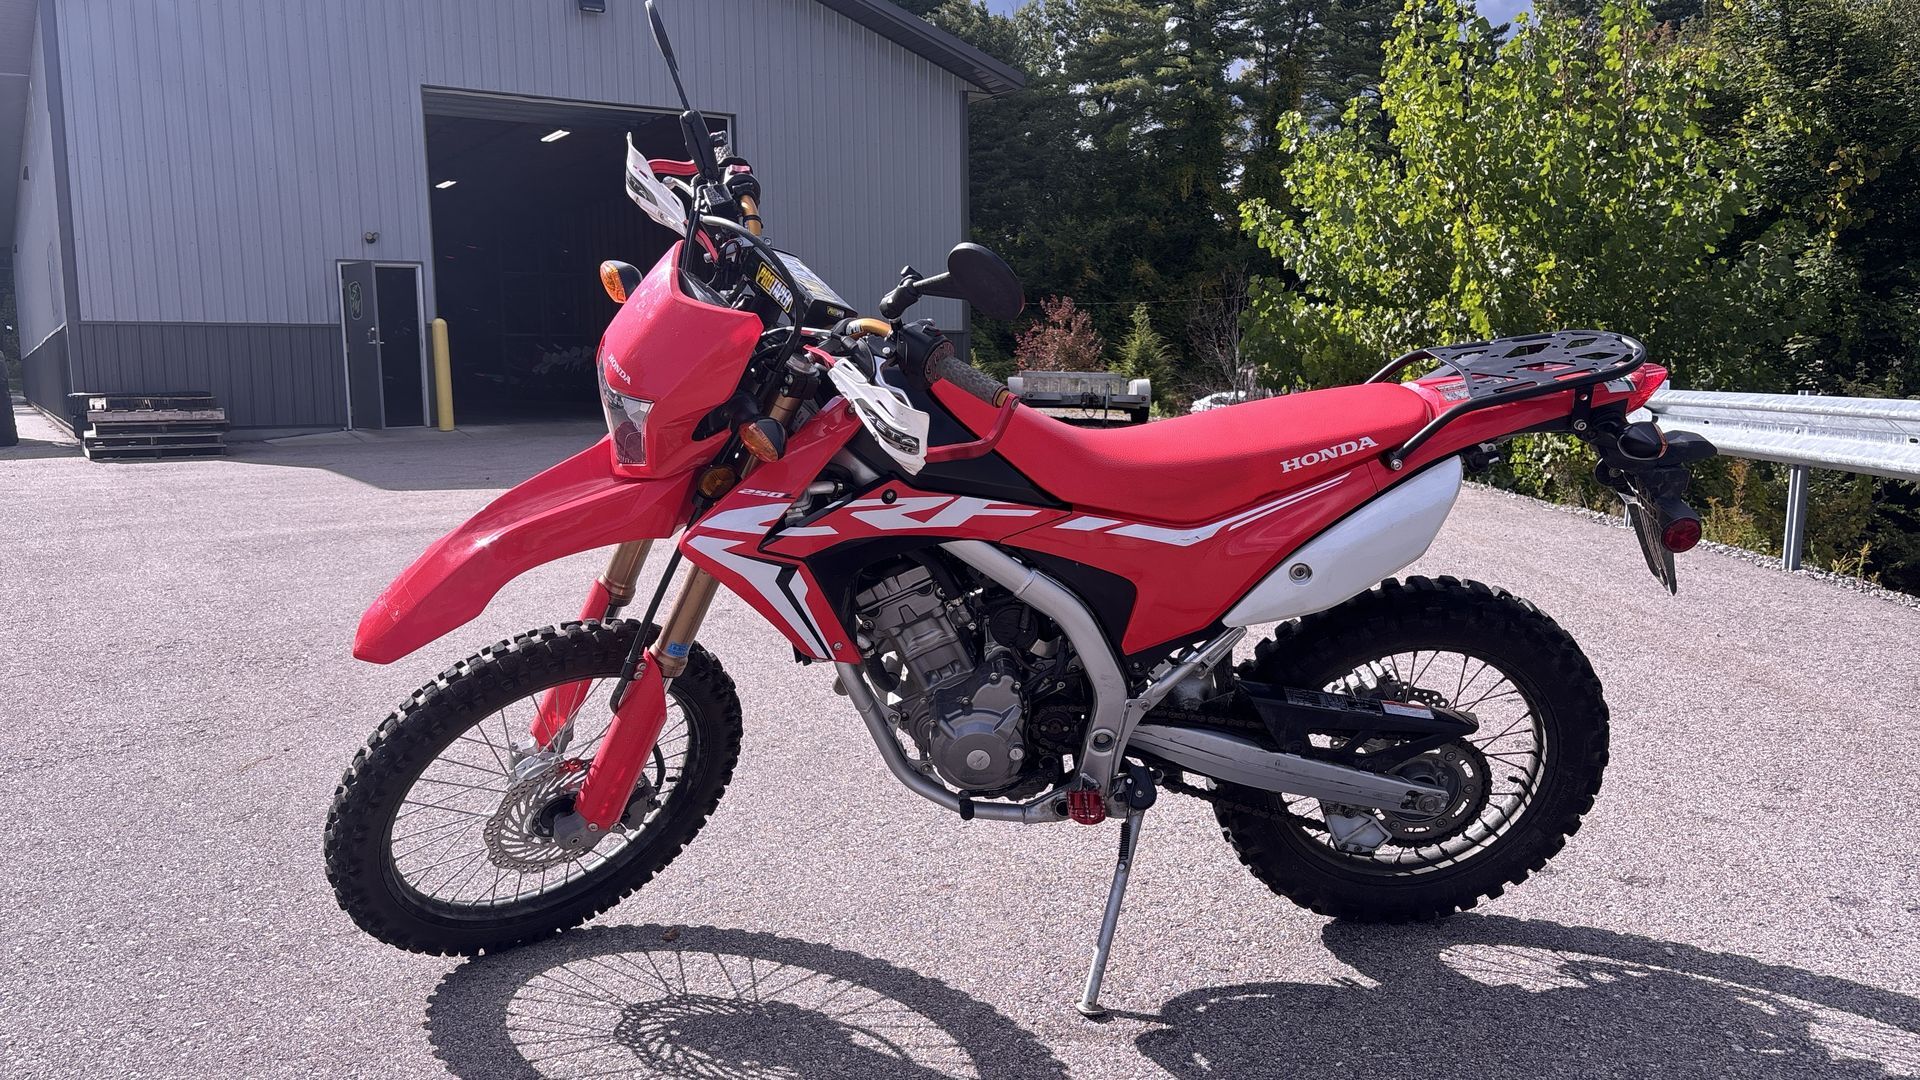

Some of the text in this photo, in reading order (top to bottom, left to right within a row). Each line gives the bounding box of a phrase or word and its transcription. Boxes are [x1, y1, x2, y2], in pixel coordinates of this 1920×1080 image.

[608, 352, 631, 386] HONDA
[865, 410, 917, 447] ZETA
[1280, 436, 1379, 473] HONDA
[700, 496, 1043, 536] CRF
